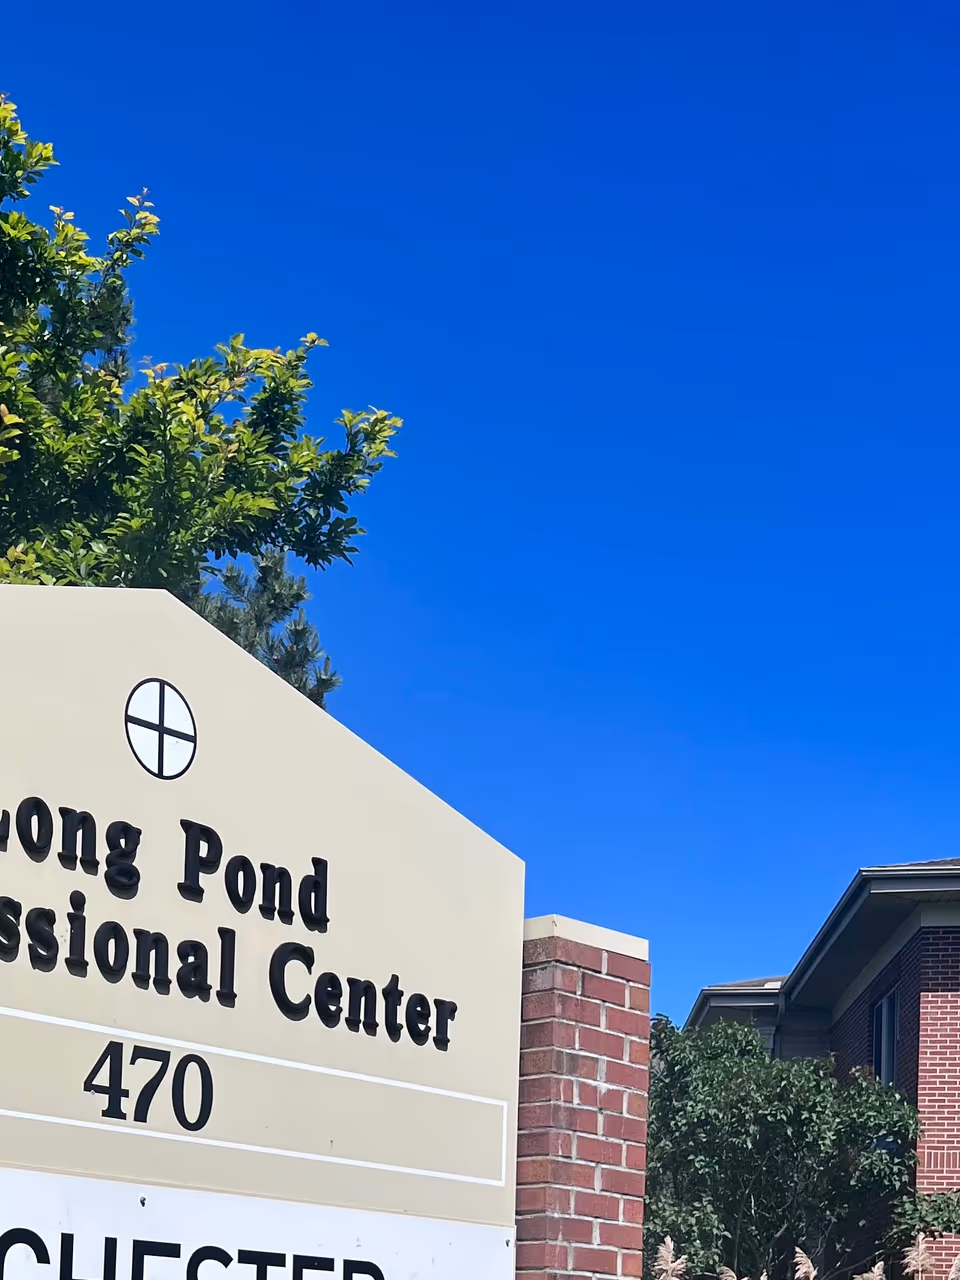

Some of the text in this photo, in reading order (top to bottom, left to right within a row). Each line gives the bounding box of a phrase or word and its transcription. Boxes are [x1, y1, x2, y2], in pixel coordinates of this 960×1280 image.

[176, 818, 330, 934] Pond
[268, 941, 458, 1052] Center
[83, 1040, 214, 1132] 470
